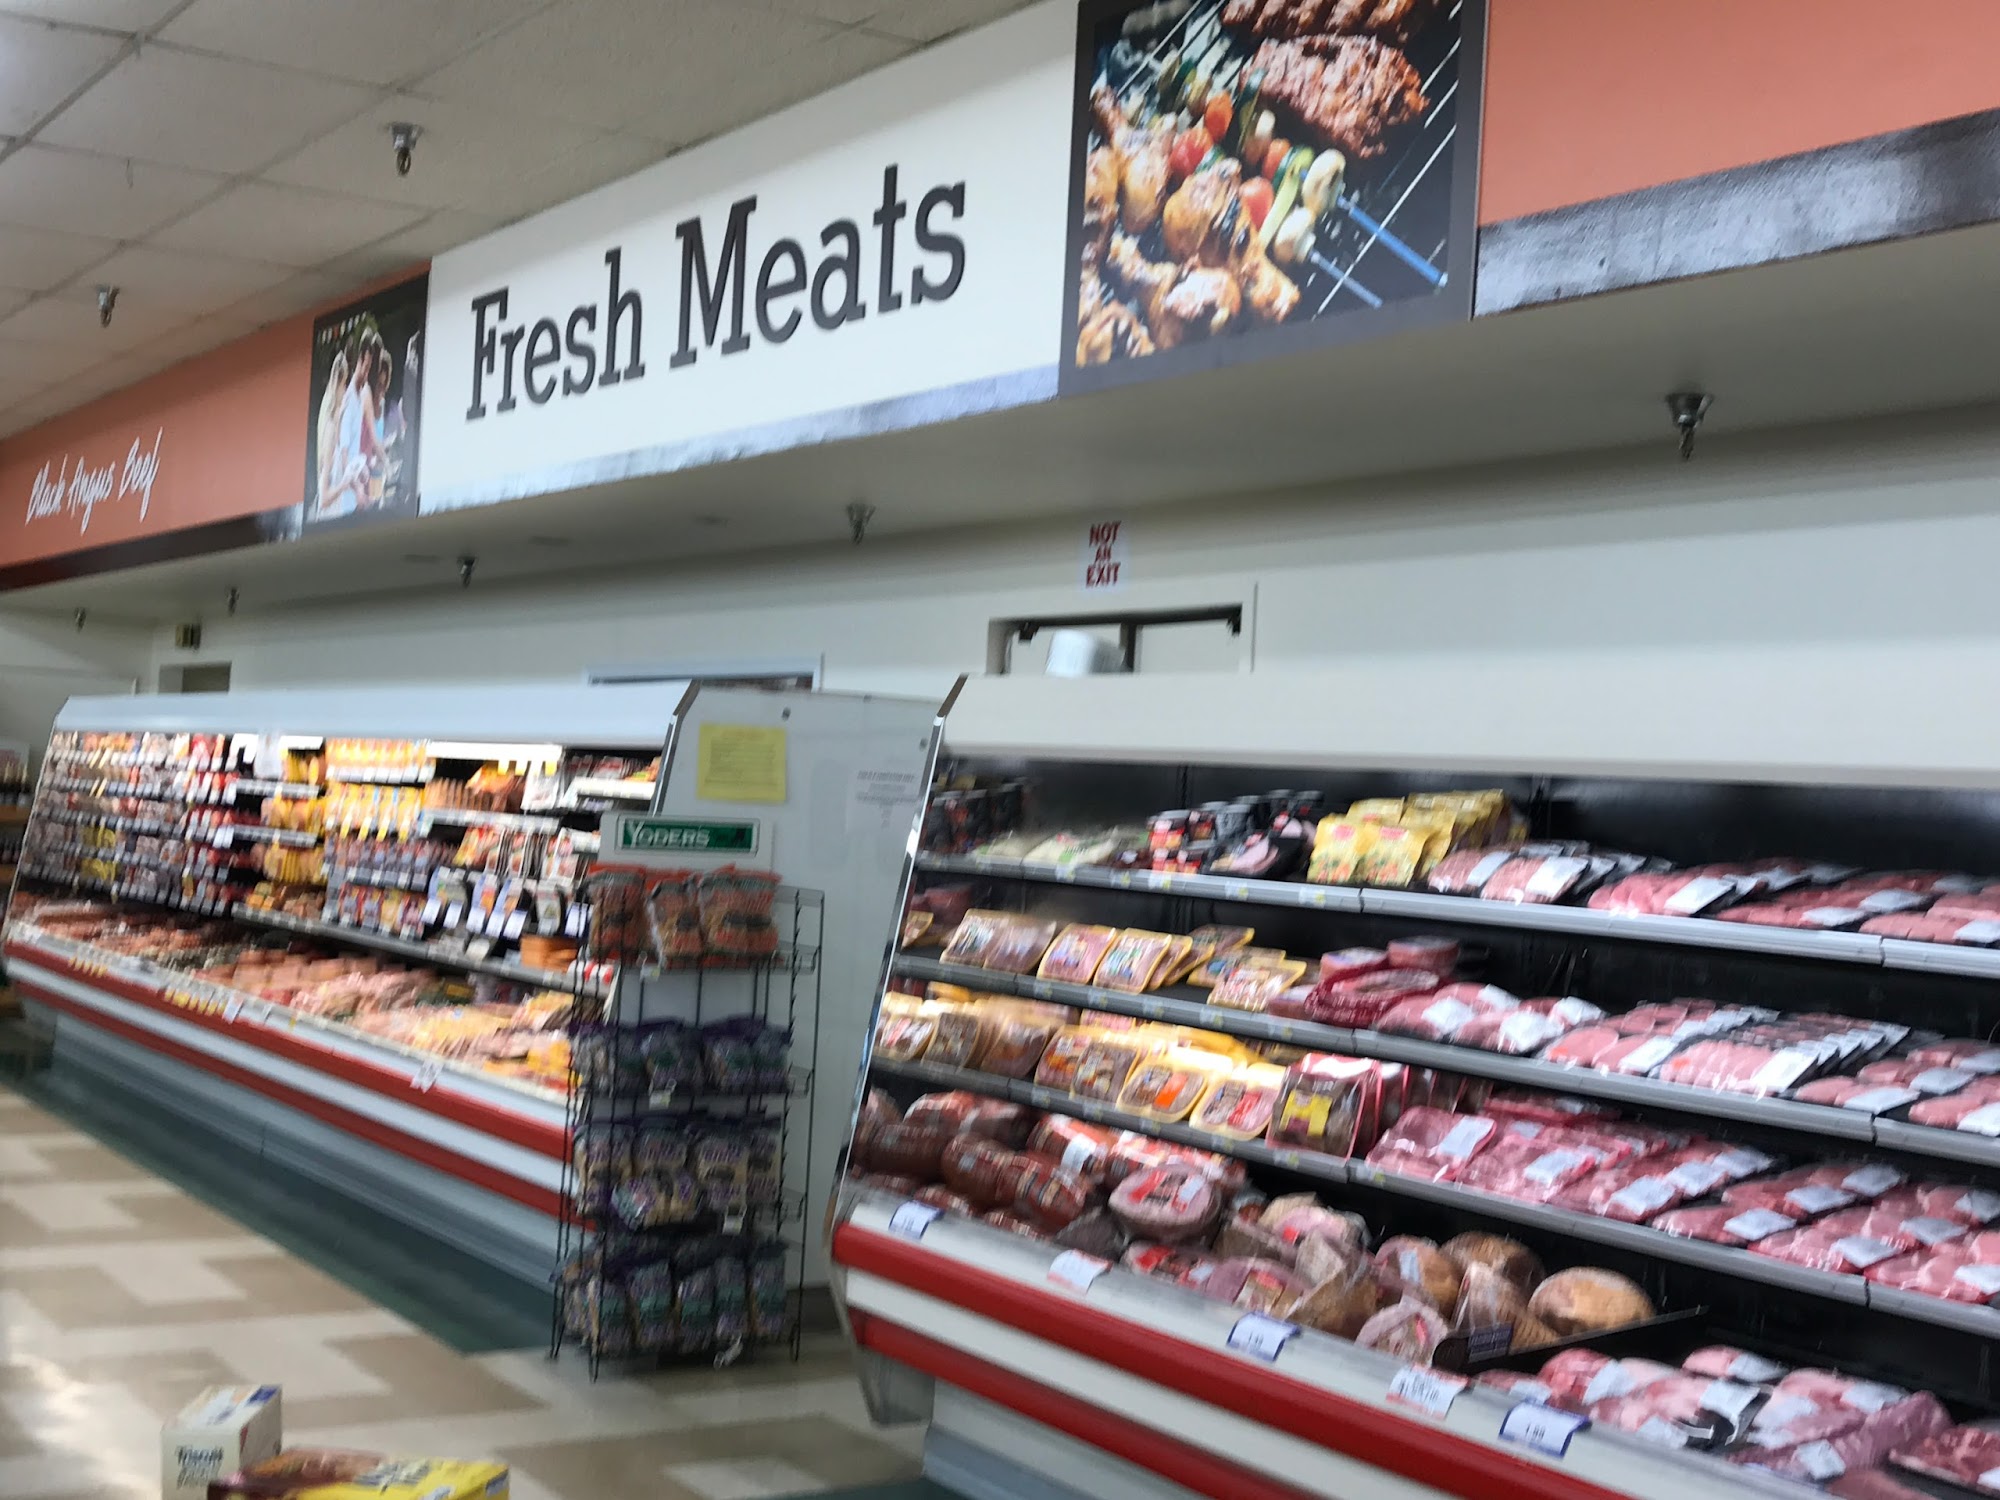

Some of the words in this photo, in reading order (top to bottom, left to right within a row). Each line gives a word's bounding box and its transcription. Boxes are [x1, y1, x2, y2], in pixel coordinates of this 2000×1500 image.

[466, 246, 645, 420] Fresh
[670, 164, 966, 368] Meats
[25, 453, 68, 526] Black
[66, 456, 116, 537] Angus
[117, 426, 164, 523] Beef
[1089, 520, 1121, 547] NOT
[1094, 544, 1112, 564] AN
[1086, 562, 1121, 588] EXIT
